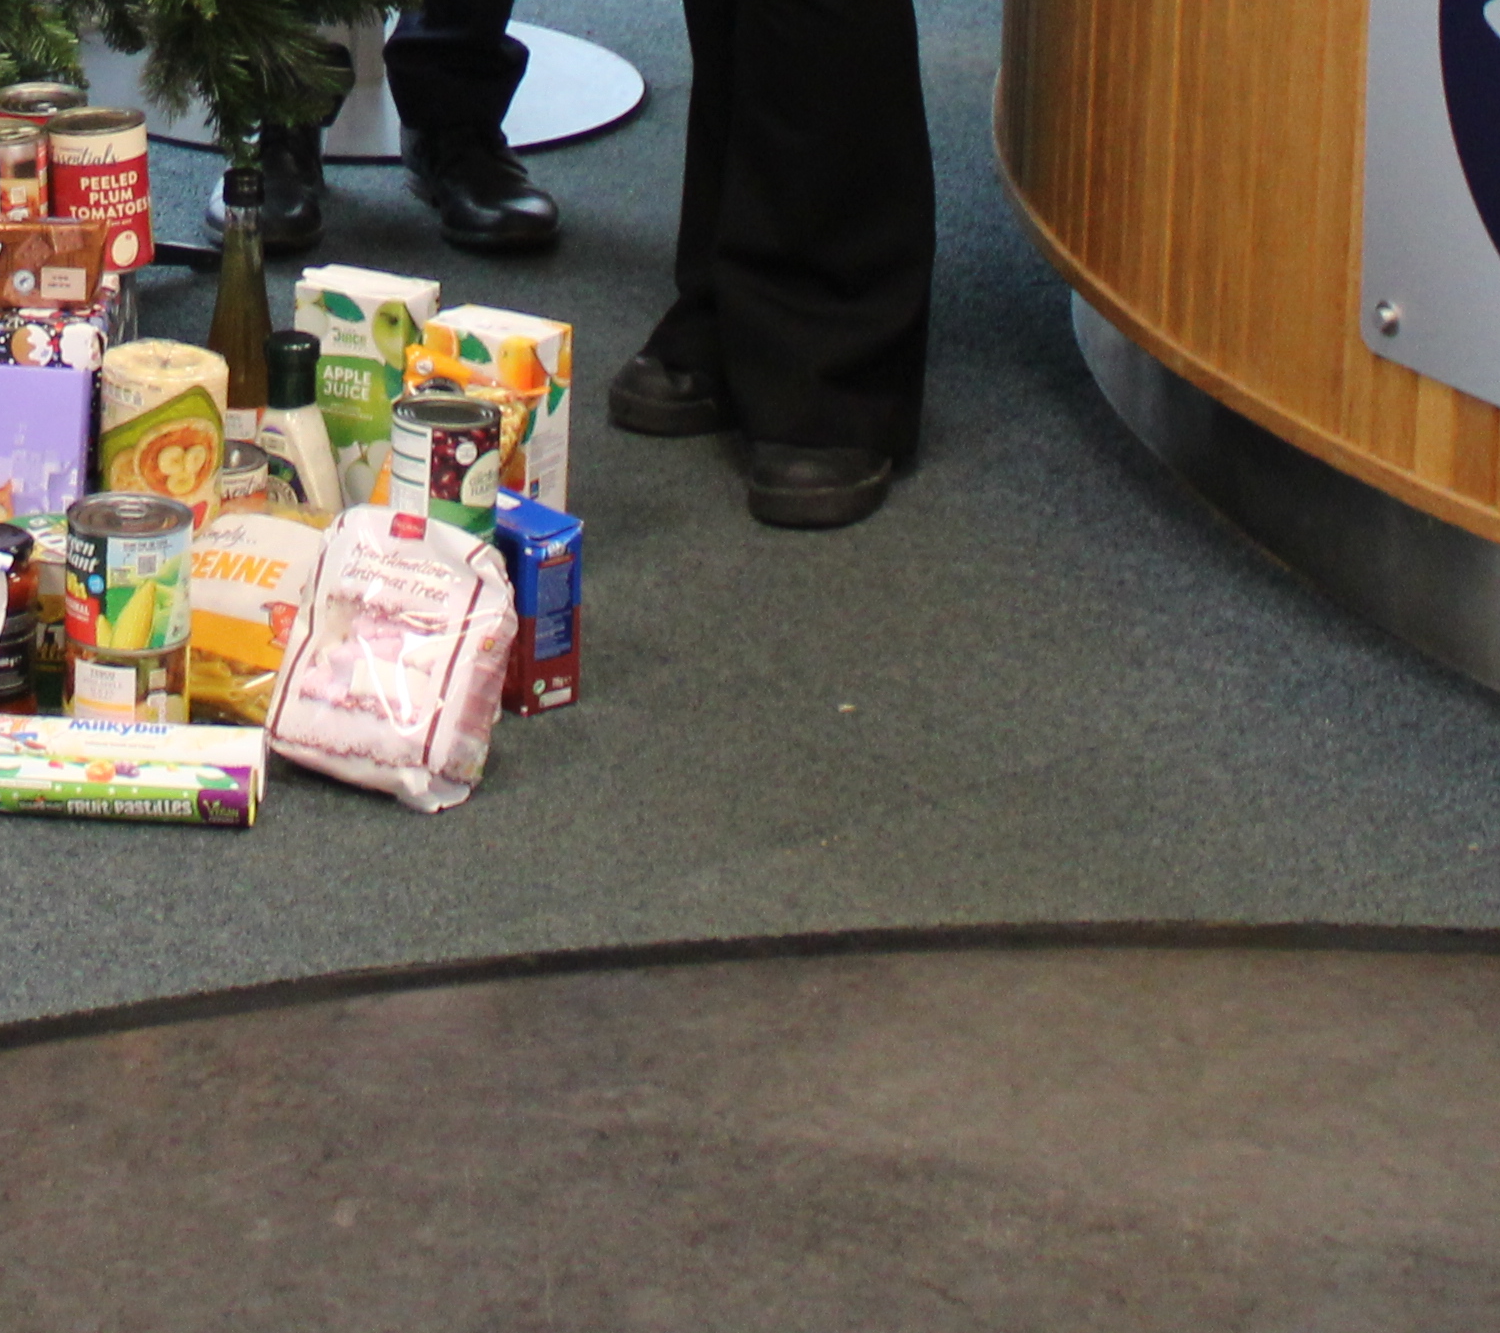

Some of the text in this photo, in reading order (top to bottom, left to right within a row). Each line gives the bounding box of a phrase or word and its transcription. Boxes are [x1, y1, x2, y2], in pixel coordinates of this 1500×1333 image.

[80, 171, 139, 191] PEELED
[89, 187, 134, 205] PLUM
[69, 197, 150, 220] TOMATOES
[322, 364, 372, 385] APPLE
[323, 382, 371, 402] JUICE
[411, 580, 449, 602] Trees
